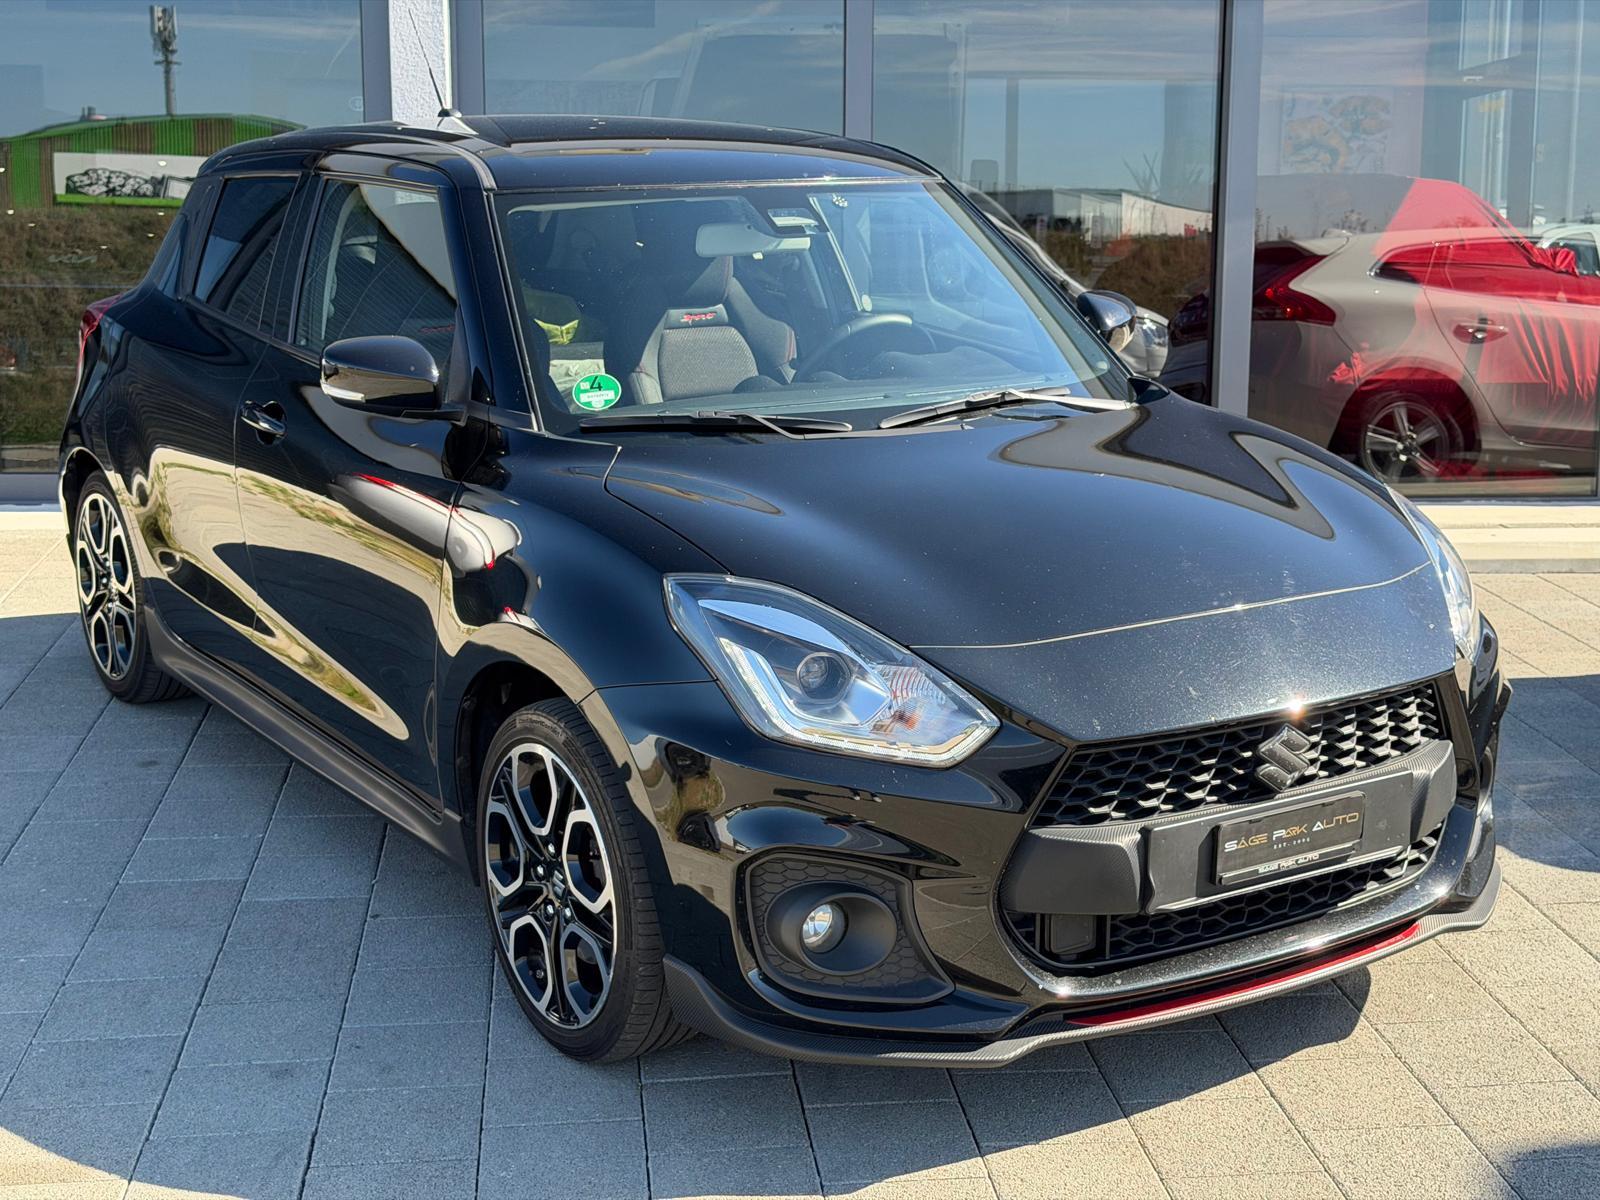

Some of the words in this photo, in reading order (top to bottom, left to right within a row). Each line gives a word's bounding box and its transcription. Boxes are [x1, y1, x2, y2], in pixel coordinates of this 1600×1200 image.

[590, 375, 603, 391] 4
[1224, 833, 1268, 852] SAGE
[1272, 823, 1307, 841] PARK
[1311, 812, 1359, 831] AUTO
